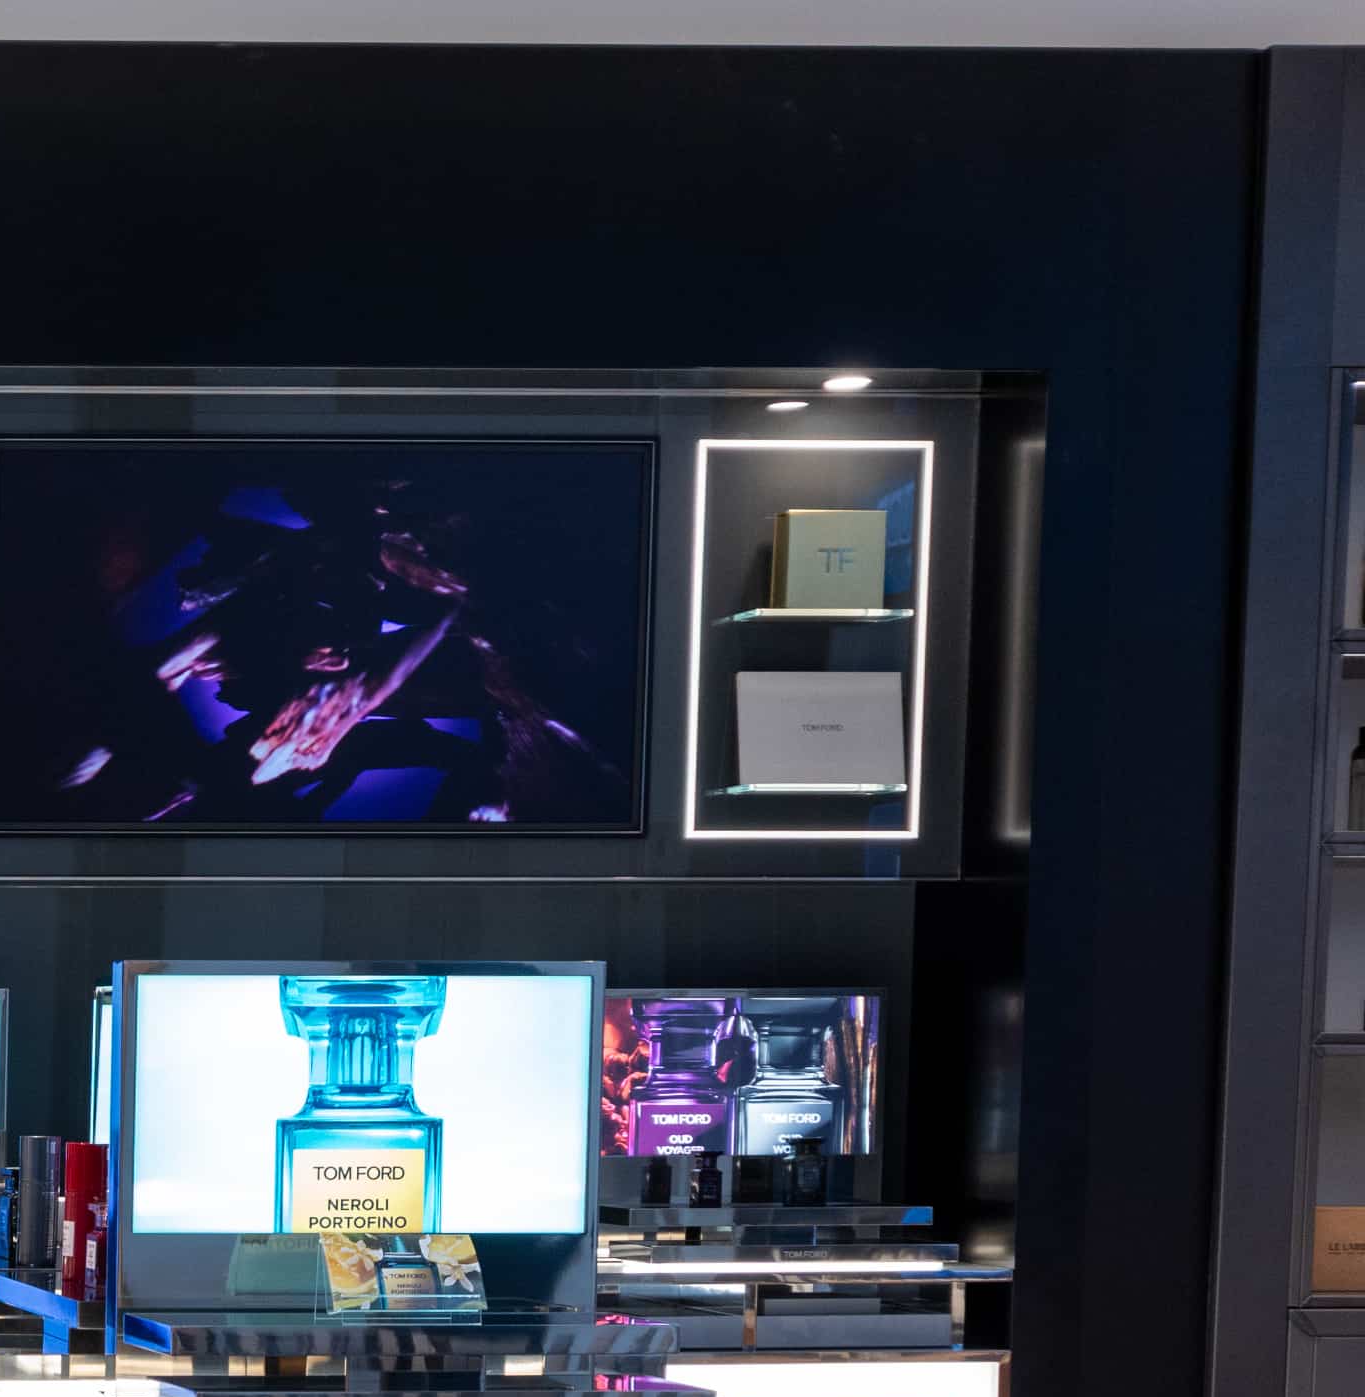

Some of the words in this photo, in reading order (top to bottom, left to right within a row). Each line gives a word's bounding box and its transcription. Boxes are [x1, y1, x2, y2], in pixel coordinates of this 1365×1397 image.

[818, 547, 855, 575] TF
[651, 1114, 678, 1125] TOM
[680, 1114, 711, 1125] FORD
[789, 1113, 821, 1124] FORD
[669, 1134, 693, 1144] OUD
[313, 1166, 352, 1180] TOM
[356, 1166, 405, 1180] FORD
[327, 1198, 389, 1211] NEROLI
[309, 1216, 407, 1229] PORTOFINO
